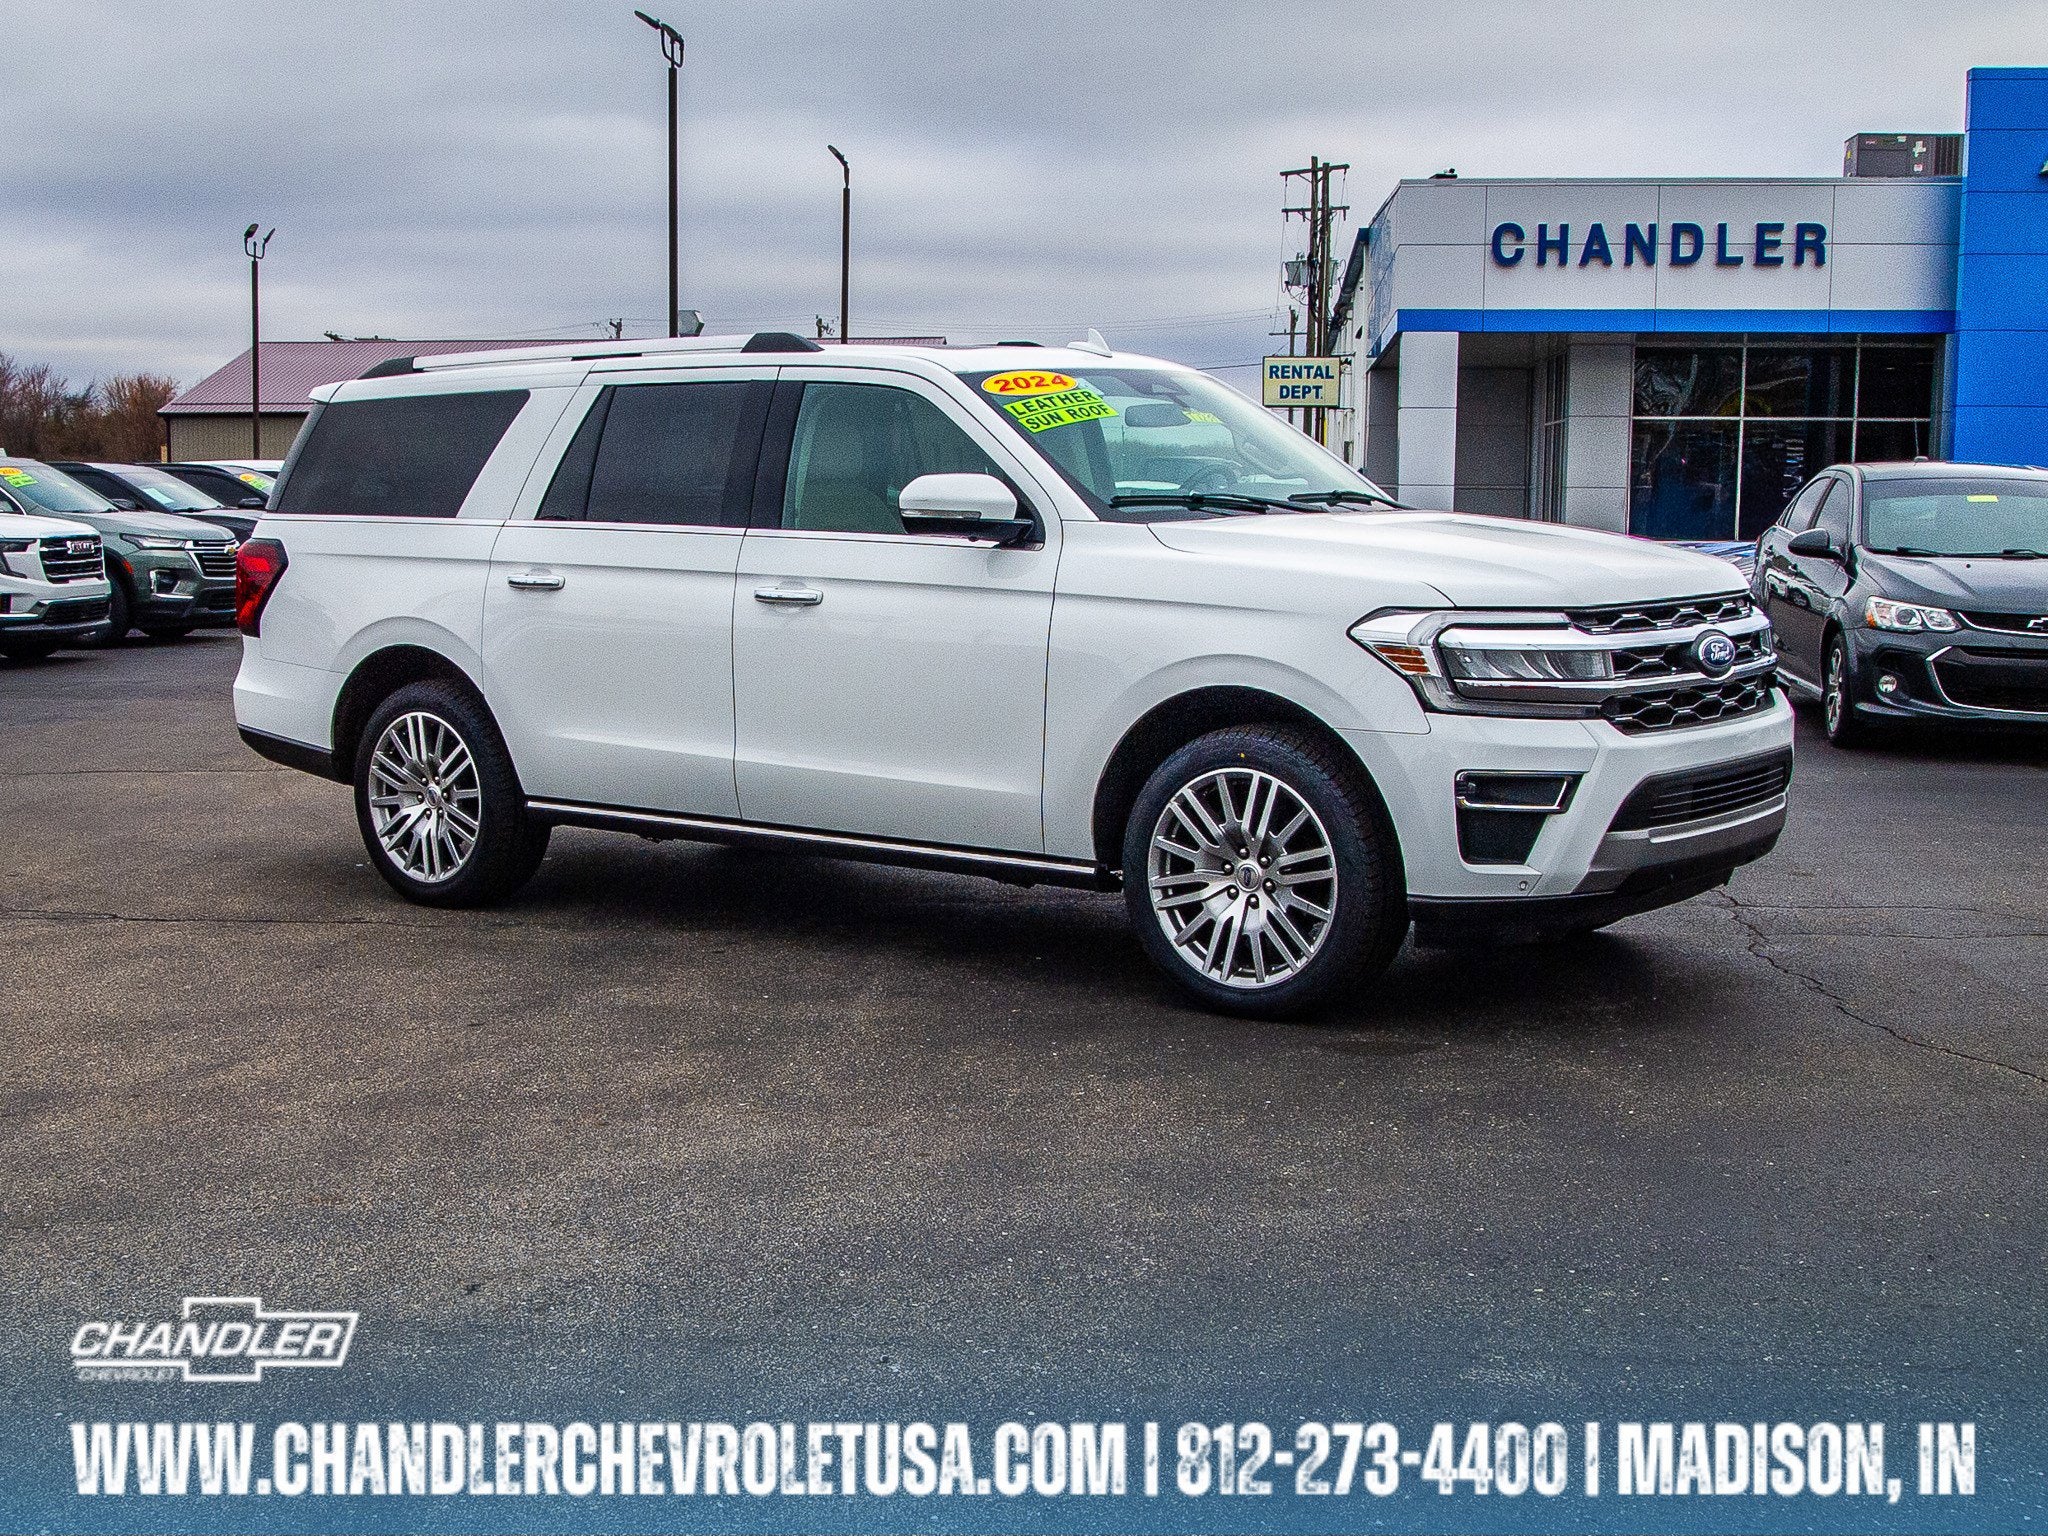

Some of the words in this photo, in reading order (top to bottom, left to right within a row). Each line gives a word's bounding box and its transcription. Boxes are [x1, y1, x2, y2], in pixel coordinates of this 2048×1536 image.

[1491, 222, 1828, 267] CHANDLER
[1269, 365, 1334, 379] RENTAL
[994, 374, 1068, 393] 2024
[1279, 385, 1323, 399] DEPT.
[1012, 390, 1100, 417] LEATHER
[1026, 412, 1066, 430] SUN
[1069, 404, 1112, 420] ROOF
